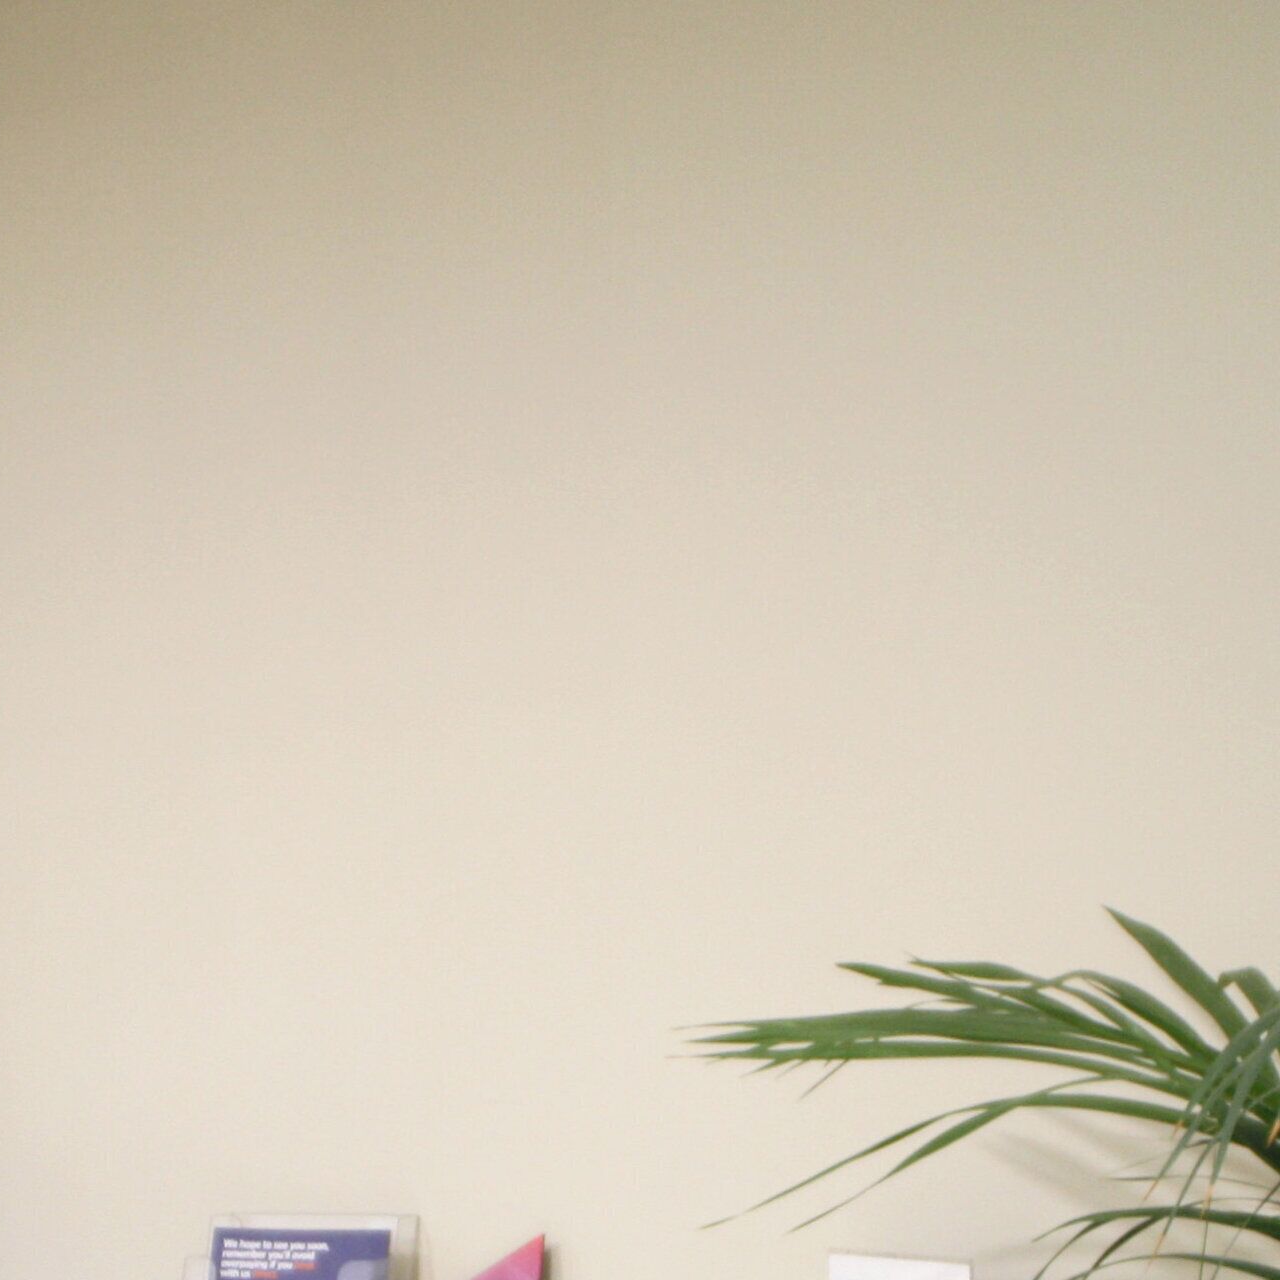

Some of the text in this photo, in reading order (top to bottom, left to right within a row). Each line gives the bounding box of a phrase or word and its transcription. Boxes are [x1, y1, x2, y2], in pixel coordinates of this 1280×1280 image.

[223, 1238, 238, 1249] We
[239, 1239, 261, 1251] hope
[262, 1240, 272, 1250] to
[273, 1241, 289, 1251] see
[290, 1241, 306, 1252] you
[222, 1249, 266, 1260] remember
[291, 1250, 316, 1261] avoid
[221, 1260, 268, 1271] overpaying
[277, 1261, 293, 1272] you
[220, 1268, 239, 1279] with
[240, 1269, 251, 1279] us
